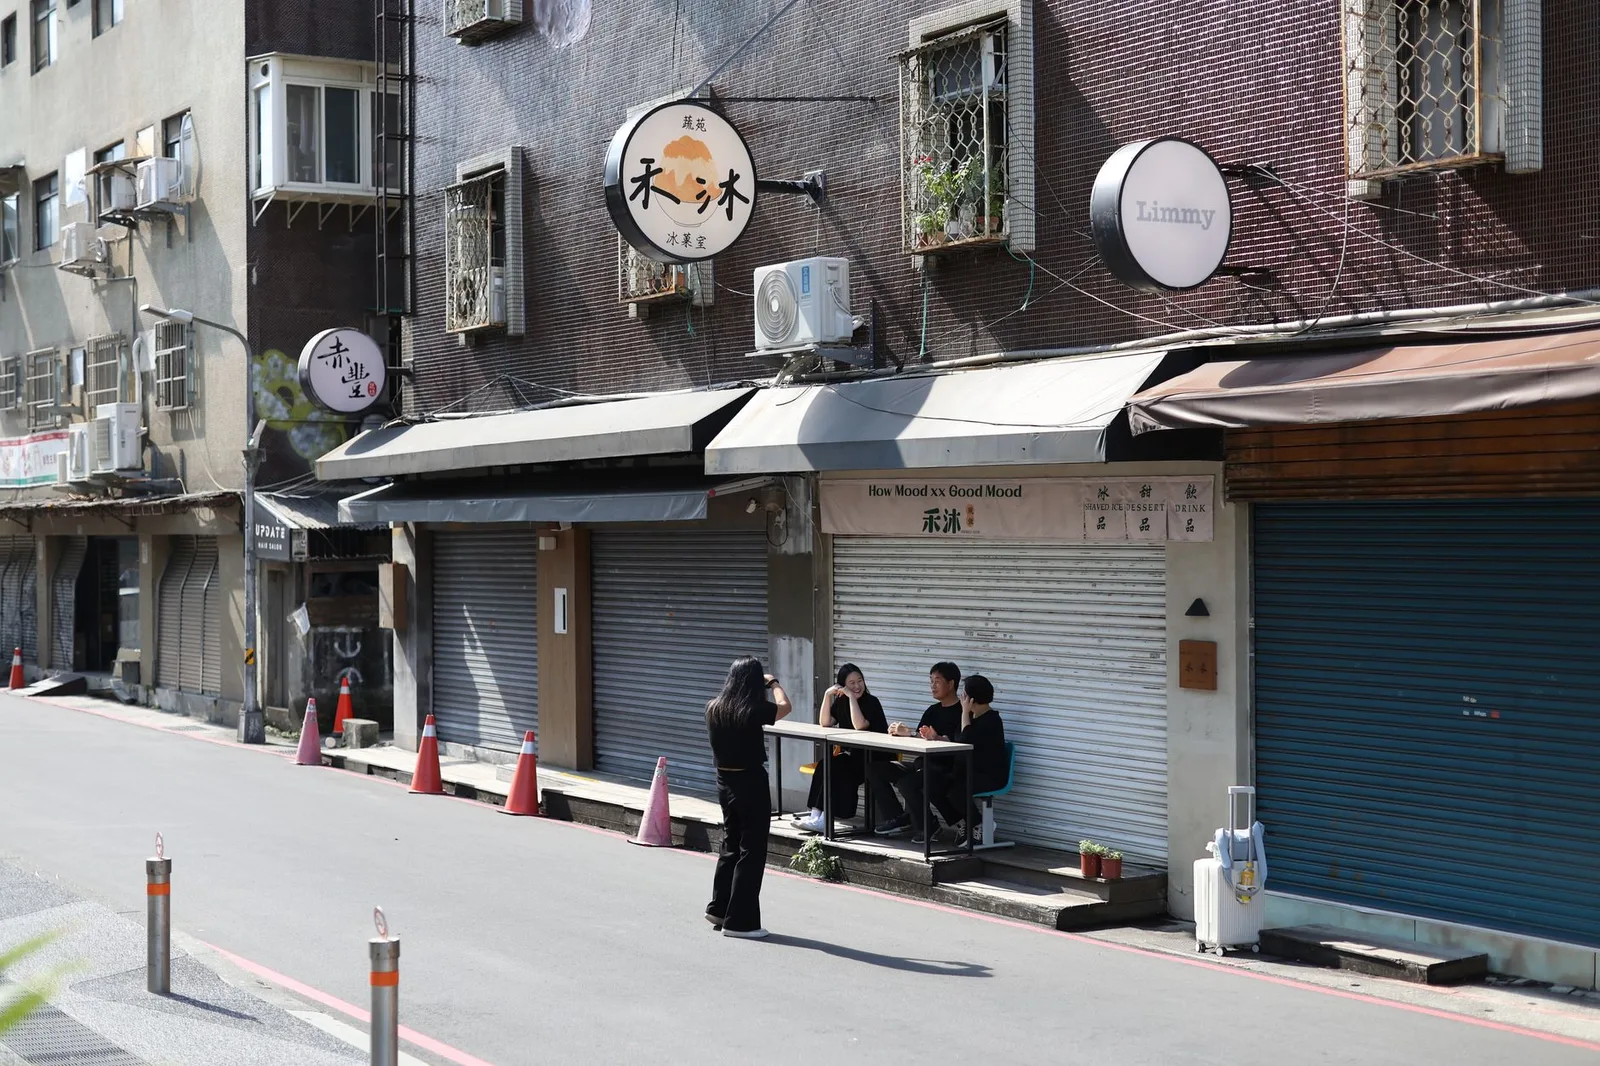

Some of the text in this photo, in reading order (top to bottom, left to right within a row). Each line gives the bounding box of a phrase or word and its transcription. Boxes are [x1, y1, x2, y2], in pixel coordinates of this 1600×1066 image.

[681, 115, 708, 133] 蔬苑
[1136, 201, 1216, 230] Limmy
[665, 231, 708, 250] 冰菓室
[868, 484, 1022, 498] How Mood xx Good Mood
[1097, 486, 1109, 500] 冰
[1139, 485, 1152, 498] 甜
[1185, 484, 1197, 499] 飲
[1084, 503, 1124, 511] SHAVED ICE
[1175, 504, 1206, 512] DRINK
[921, 507, 962, 534] 禾沐
[1097, 516, 1106, 530] 品
[1139, 517, 1151, 532] 品
[1185, 518, 1195, 533] 品
[255, 523, 286, 539] UPDATE
[268, 542, 283, 551] SALON
